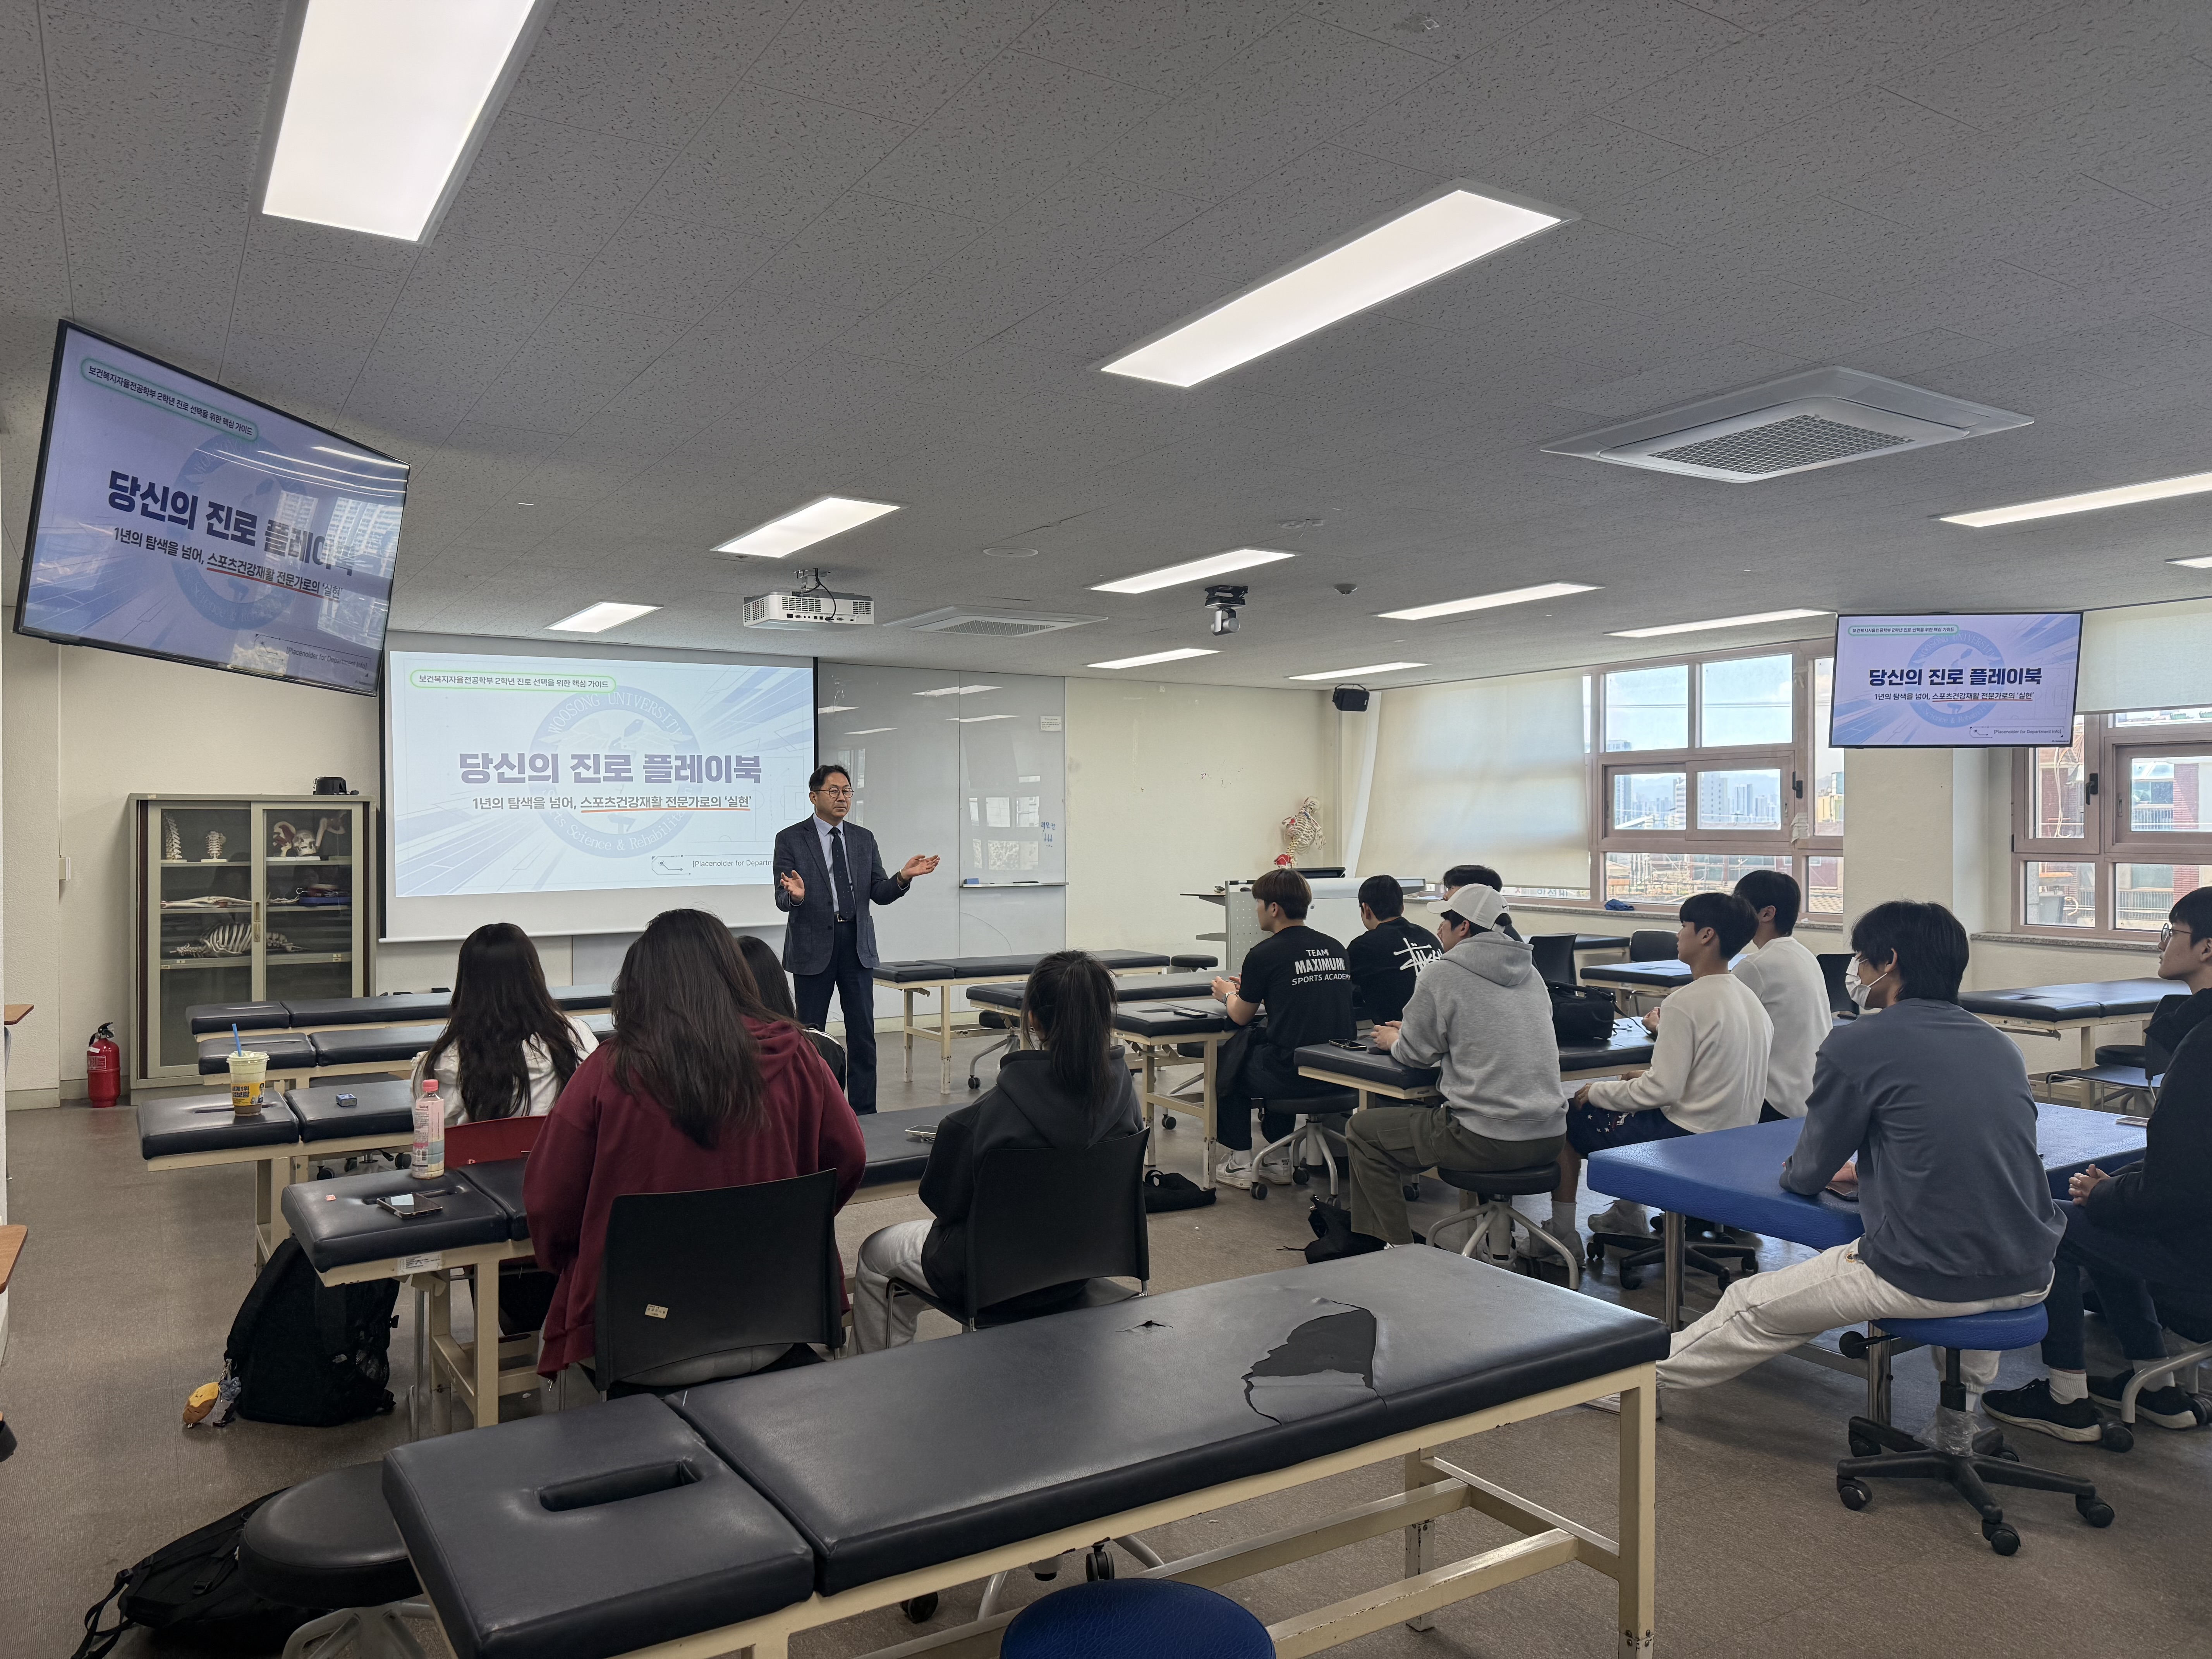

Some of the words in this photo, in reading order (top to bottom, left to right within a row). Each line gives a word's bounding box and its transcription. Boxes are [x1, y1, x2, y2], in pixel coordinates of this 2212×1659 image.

[89, 366, 156, 398] 보건복지자율전공학부
[157, 392, 175, 406] 2학년
[177, 399, 189, 411] 진로
[190, 405, 208, 419] 선택을
[209, 412, 222, 424] 위한
[223, 418, 234, 429] 핵심
[235, 422, 253, 436] 가이드
[108, 471, 198, 530] 당신의
[206, 501, 258, 546] 진로
[114, 527, 142, 548] 1년의
[145, 534, 179, 557] 탐색을
[182, 545, 204, 565] 넘어,
[207, 553, 276, 582] 스포츠건강재활
[276, 570, 319, 594] 전문가로의
[419, 675, 493, 685] 보건복지자율전공학부
[495, 678, 515, 686] 2학년
[533, 678, 555, 687] 선택을
[556, 679, 570, 687] 위한
[572, 679, 586, 688] 핵심
[588, 680, 609, 688] 가이드
[1869, 668, 1923, 686] 당신의
[1928, 668, 1964, 685] 진로
[1969, 668, 2042, 685] 플레이북
[1893, 692, 1913, 701] 탐색을
[548, 694, 601, 734] WOOSONG
[608, 691, 683, 735] UNIVERSITY
[459, 753, 559, 783] 당신의
[570, 754, 634, 783] 진로
[643, 754, 762, 784] 플레이북
[472, 797, 504, 809] 1년의
[507, 797, 546, 809] 탐색을
[550, 797, 577, 810] 넘어,
[580, 796, 663, 808] 스포츠건강재활
[666, 796, 721, 808] 전문가로의
[567, 824, 611, 850] Science
[617, 839, 625, 850] &
[1295, 958, 1345, 975] MAXIMUM
[1292, 974, 1323, 986] SPORTS
